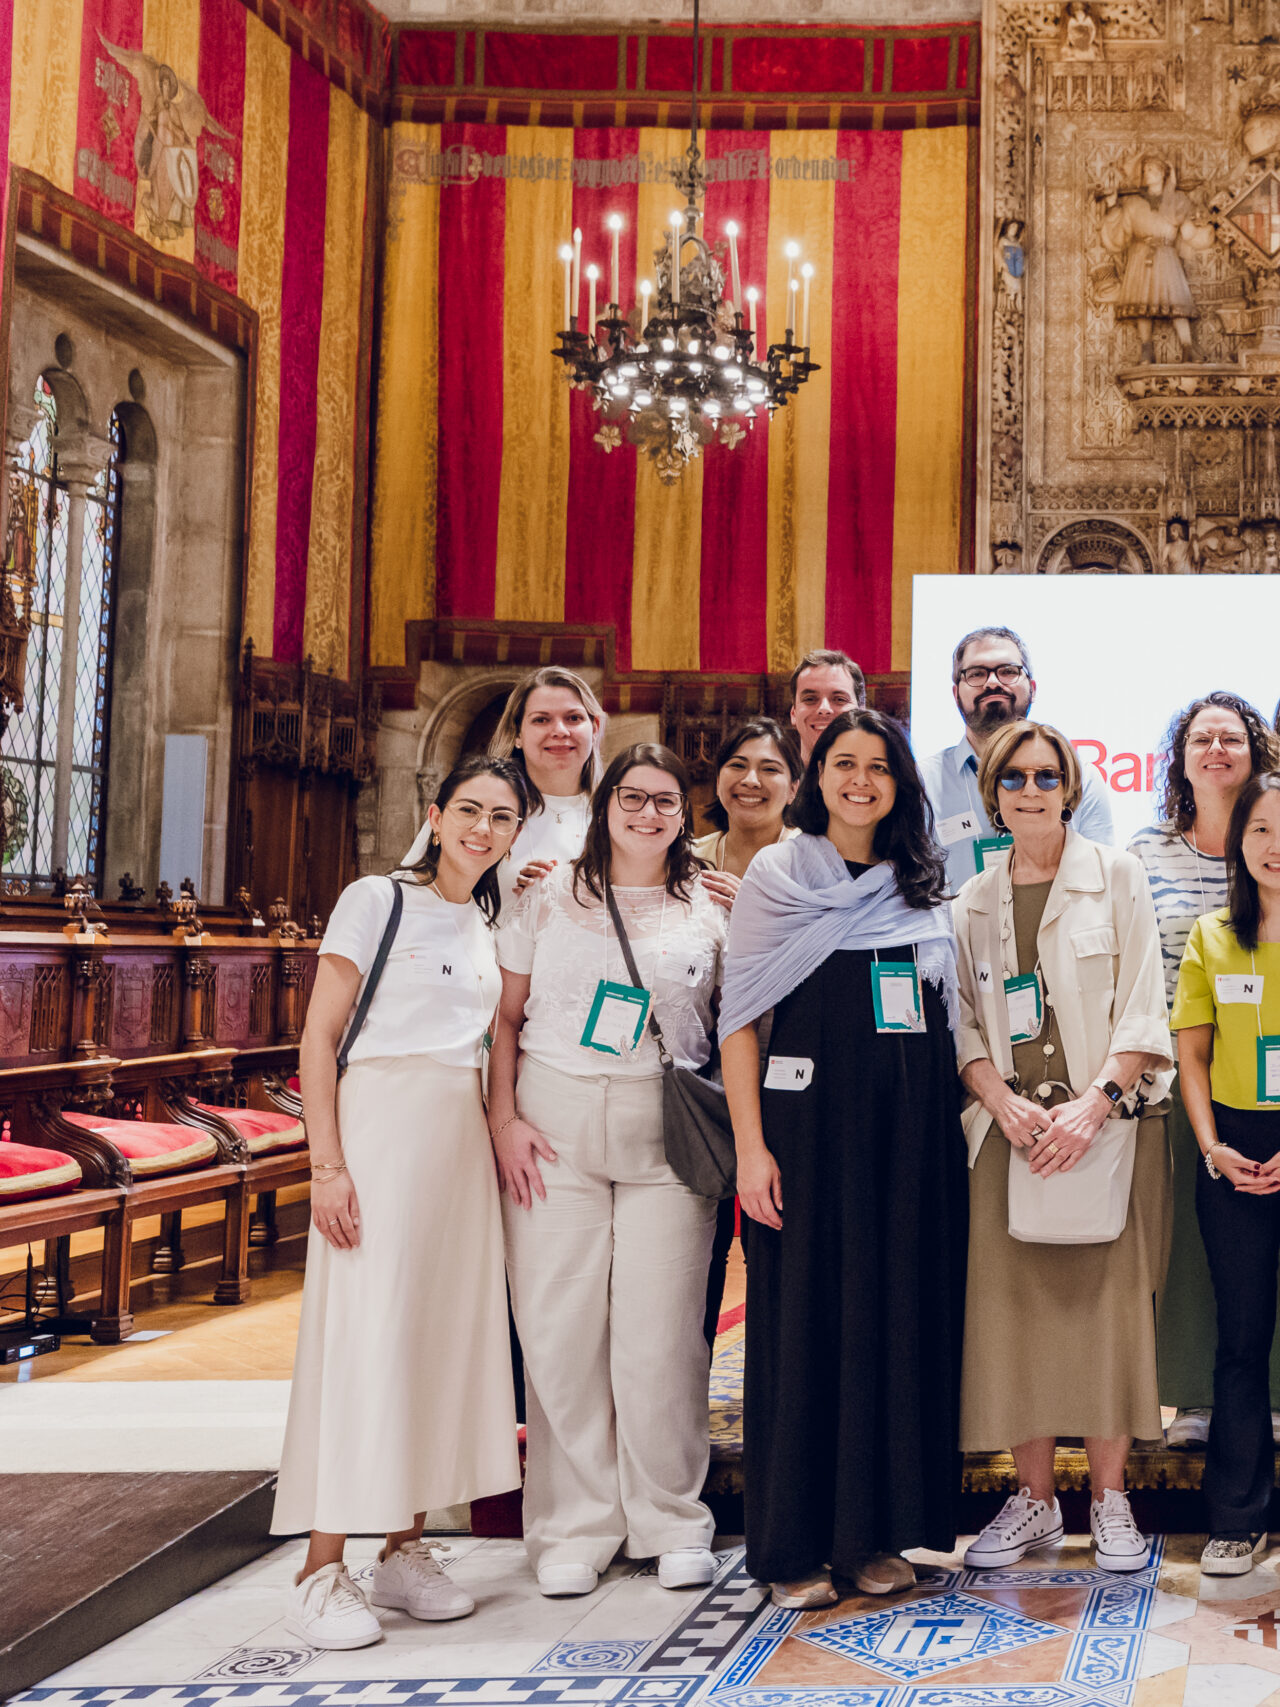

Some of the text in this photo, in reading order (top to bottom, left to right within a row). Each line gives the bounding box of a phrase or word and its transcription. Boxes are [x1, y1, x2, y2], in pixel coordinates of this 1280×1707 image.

[961, 819, 971, 829] N
[442, 965, 452, 976] N
[979, 971, 989, 982] N
[1243, 984, 1254, 993] N
[795, 1069, 804, 1079] N
